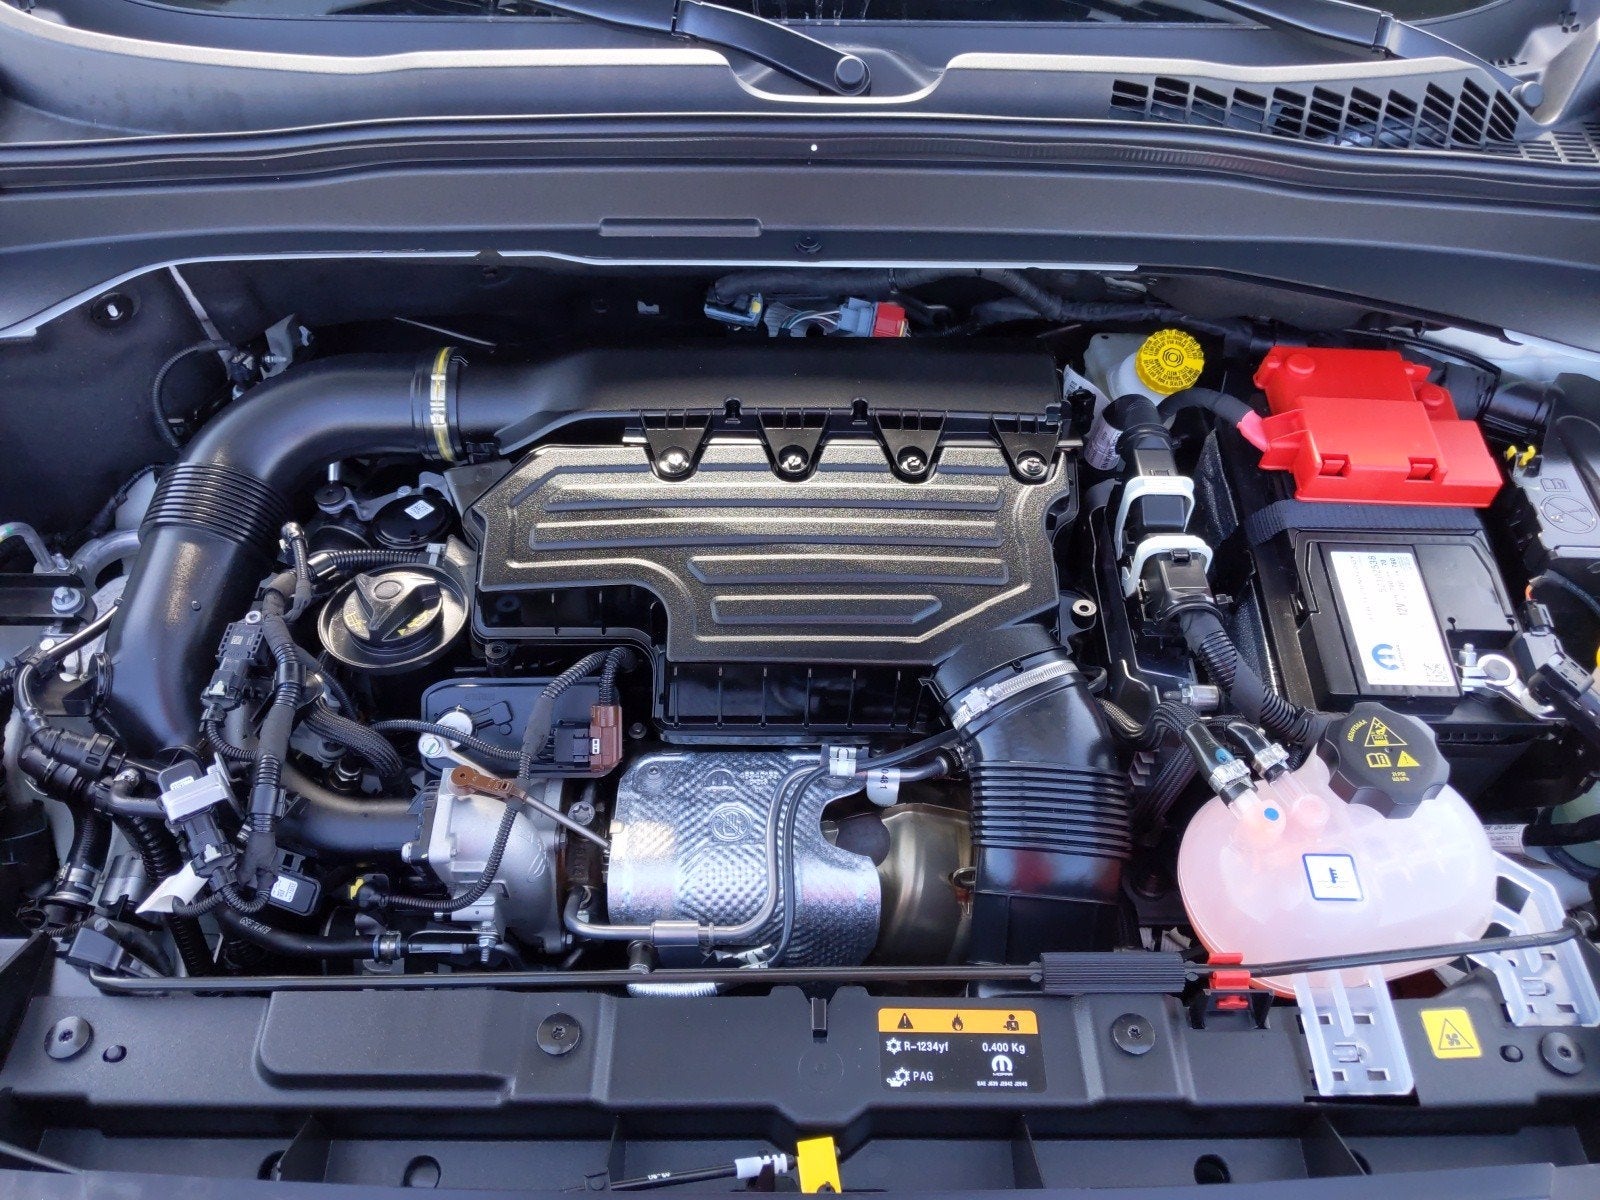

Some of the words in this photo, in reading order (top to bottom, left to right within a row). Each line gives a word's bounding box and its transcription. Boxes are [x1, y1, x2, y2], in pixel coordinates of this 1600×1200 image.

[904, 1042, 949, 1054] R-1234yf
[982, 1042, 1008, 1052] 0.400
[1012, 1043, 1025, 1054] Kg
[913, 1071, 934, 1081] PAG
